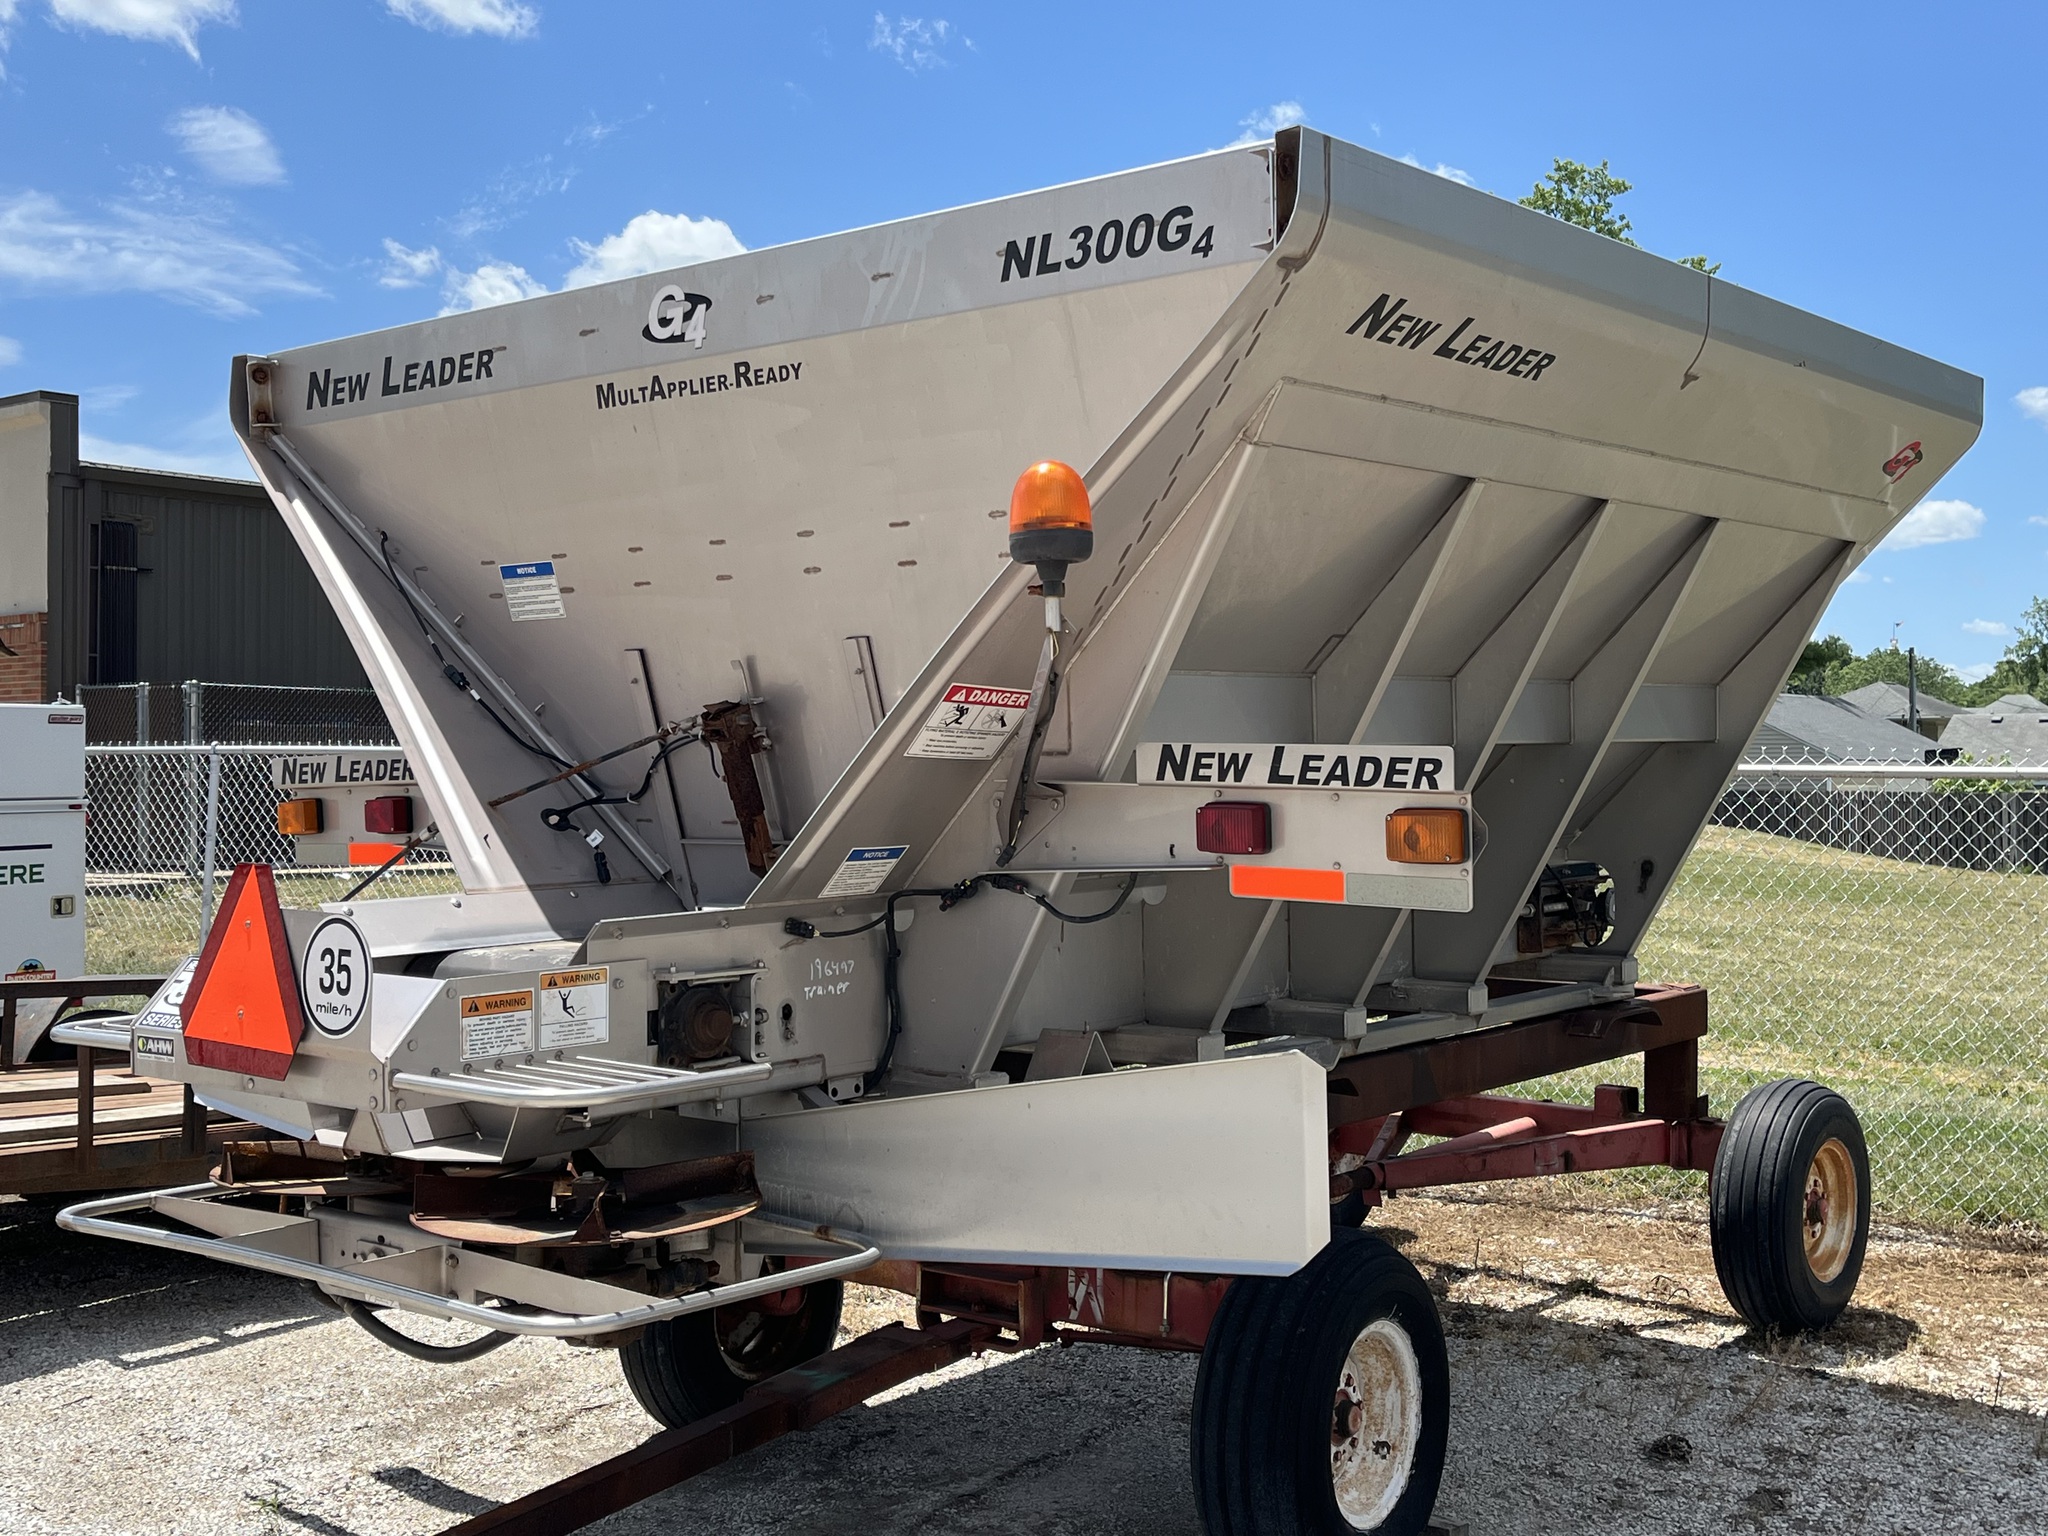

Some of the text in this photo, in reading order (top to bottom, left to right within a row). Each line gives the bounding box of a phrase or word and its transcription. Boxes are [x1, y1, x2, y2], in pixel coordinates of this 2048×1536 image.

[968, 690, 1029, 706] DANGER
[862, 851, 889, 859] NOTICE
[319, 947, 352, 996] 35
[562, 972, 601, 984] WARNING
[315, 1001, 352, 1017] mile/h
[485, 997, 527, 1010] WARNING
[146, 1039, 173, 1054] AHW
